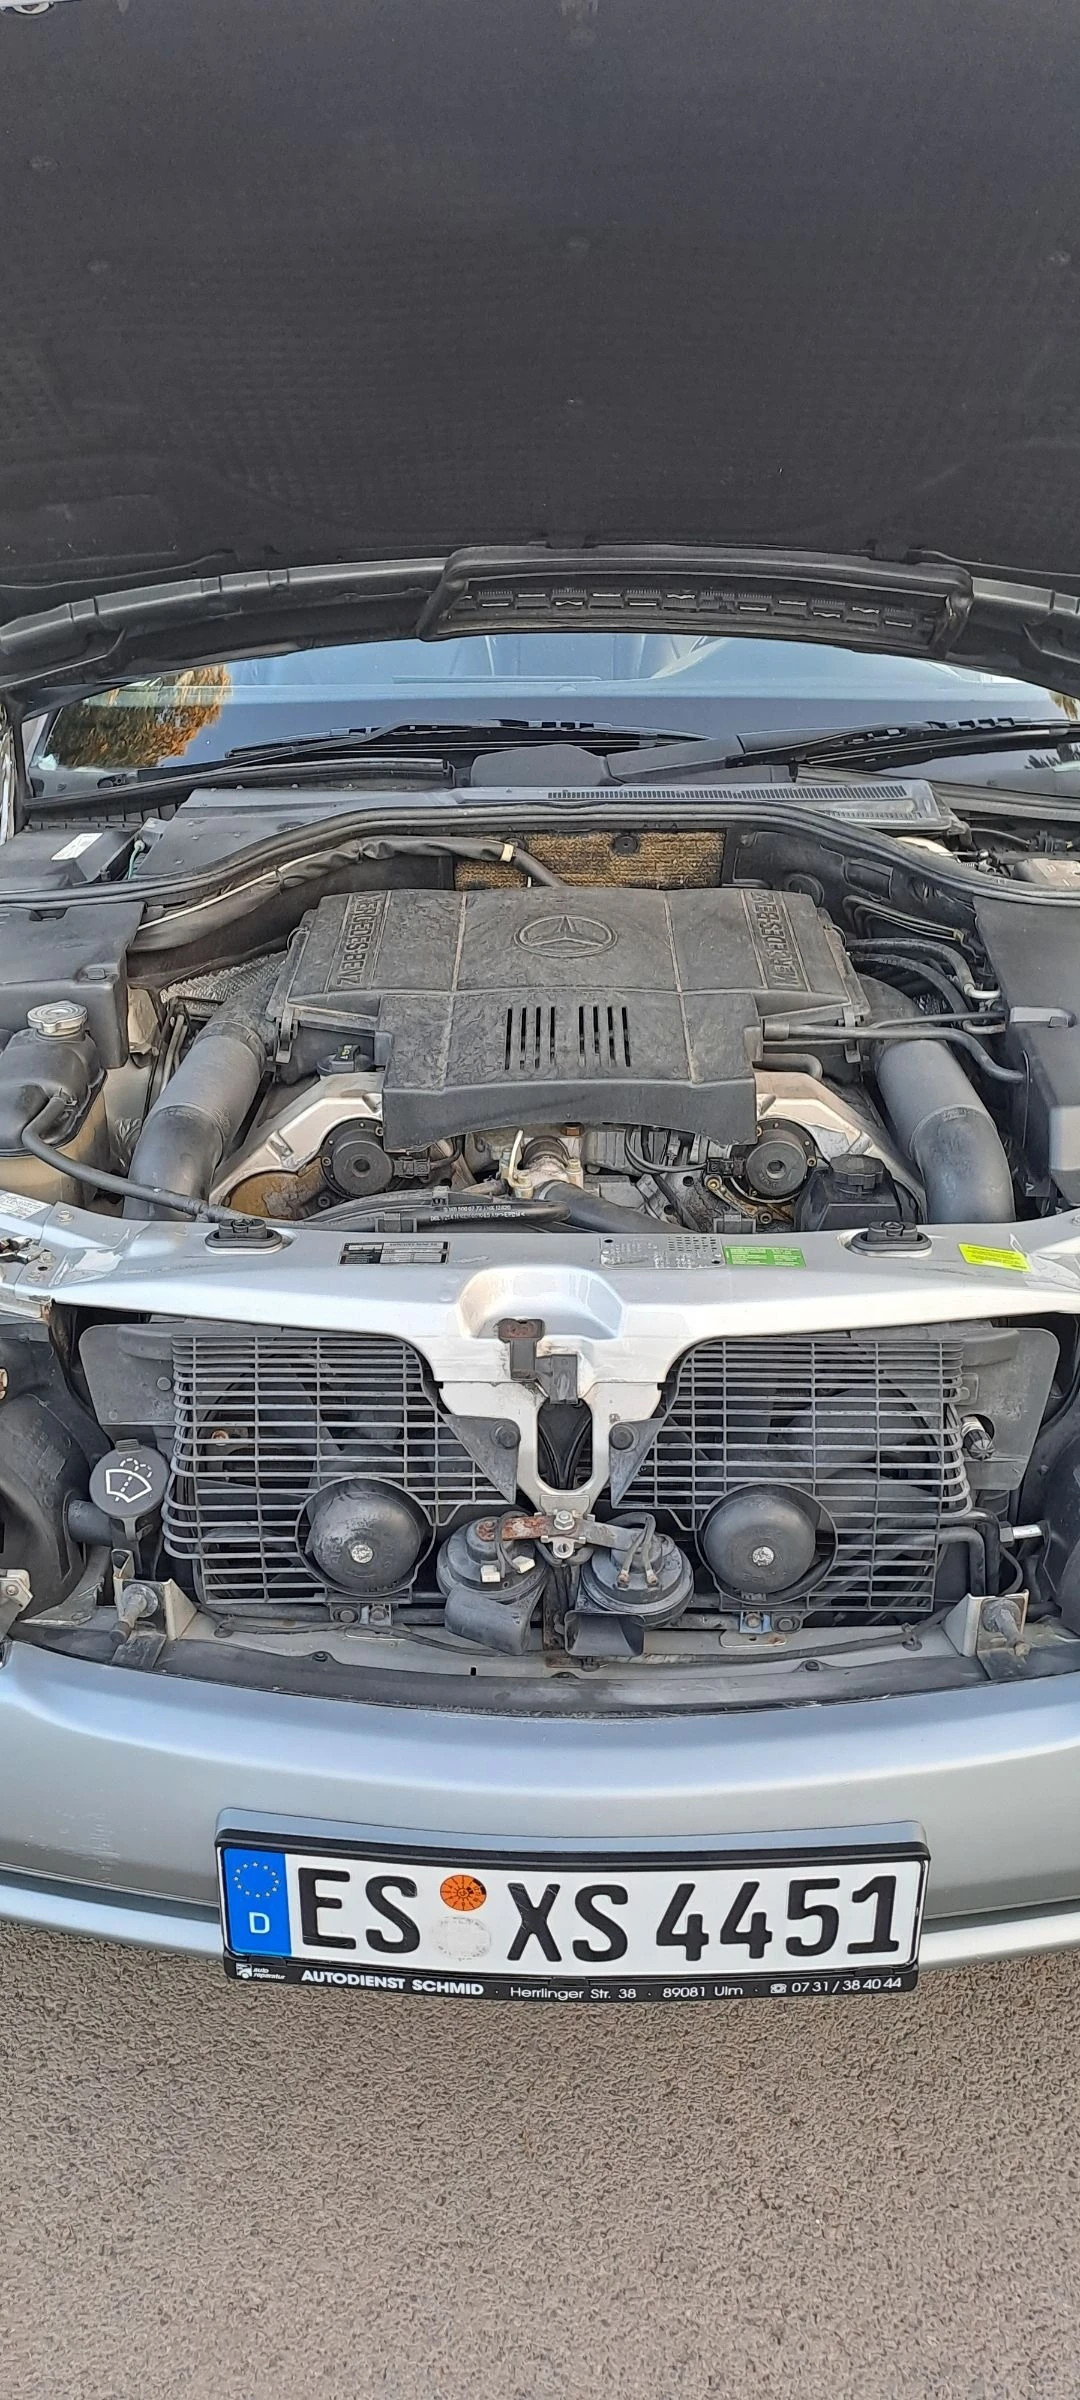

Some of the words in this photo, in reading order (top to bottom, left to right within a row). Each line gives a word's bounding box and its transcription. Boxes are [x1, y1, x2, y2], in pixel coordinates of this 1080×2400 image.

[249, 1911, 270, 1934] D
[298, 1867, 420, 1954] ES
[507, 1883, 629, 1961] XS
[656, 1876, 900, 1961] 4451
[301, 1969, 405, 1989] AUTODIENST
[411, 1979, 484, 1996] SCHMID
[510, 1986, 584, 2001] Herrlinger
[590, 1988, 612, 1999] Str.
[618, 1988, 637, 1999] 38
[662, 1986, 705, 1998] 89081
[714, 1985, 744, 1997] Ulm
